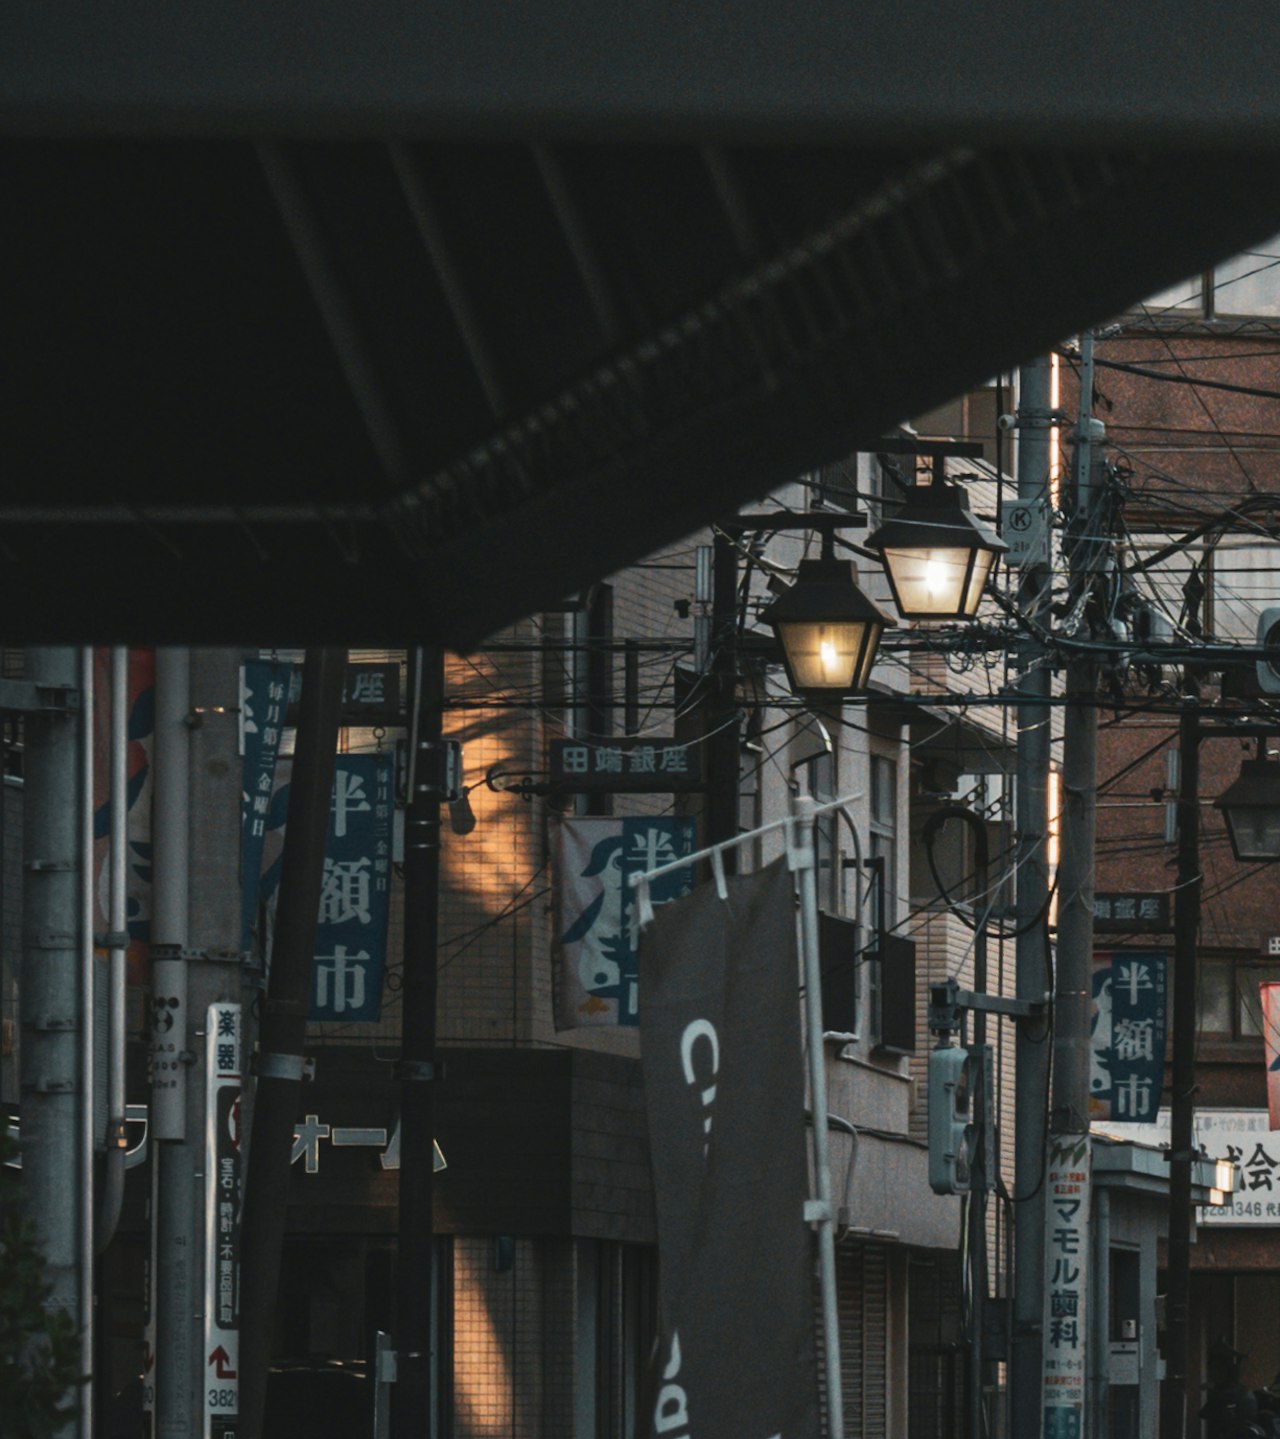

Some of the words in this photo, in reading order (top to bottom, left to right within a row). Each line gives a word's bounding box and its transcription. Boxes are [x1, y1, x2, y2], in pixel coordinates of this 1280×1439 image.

[562, 744, 690, 774] 田端銀座
[312, 770, 372, 1014] 半額市
[1114, 961, 1154, 1118] 半額市
[1050, 1199, 1082, 1349] マモル歯科
